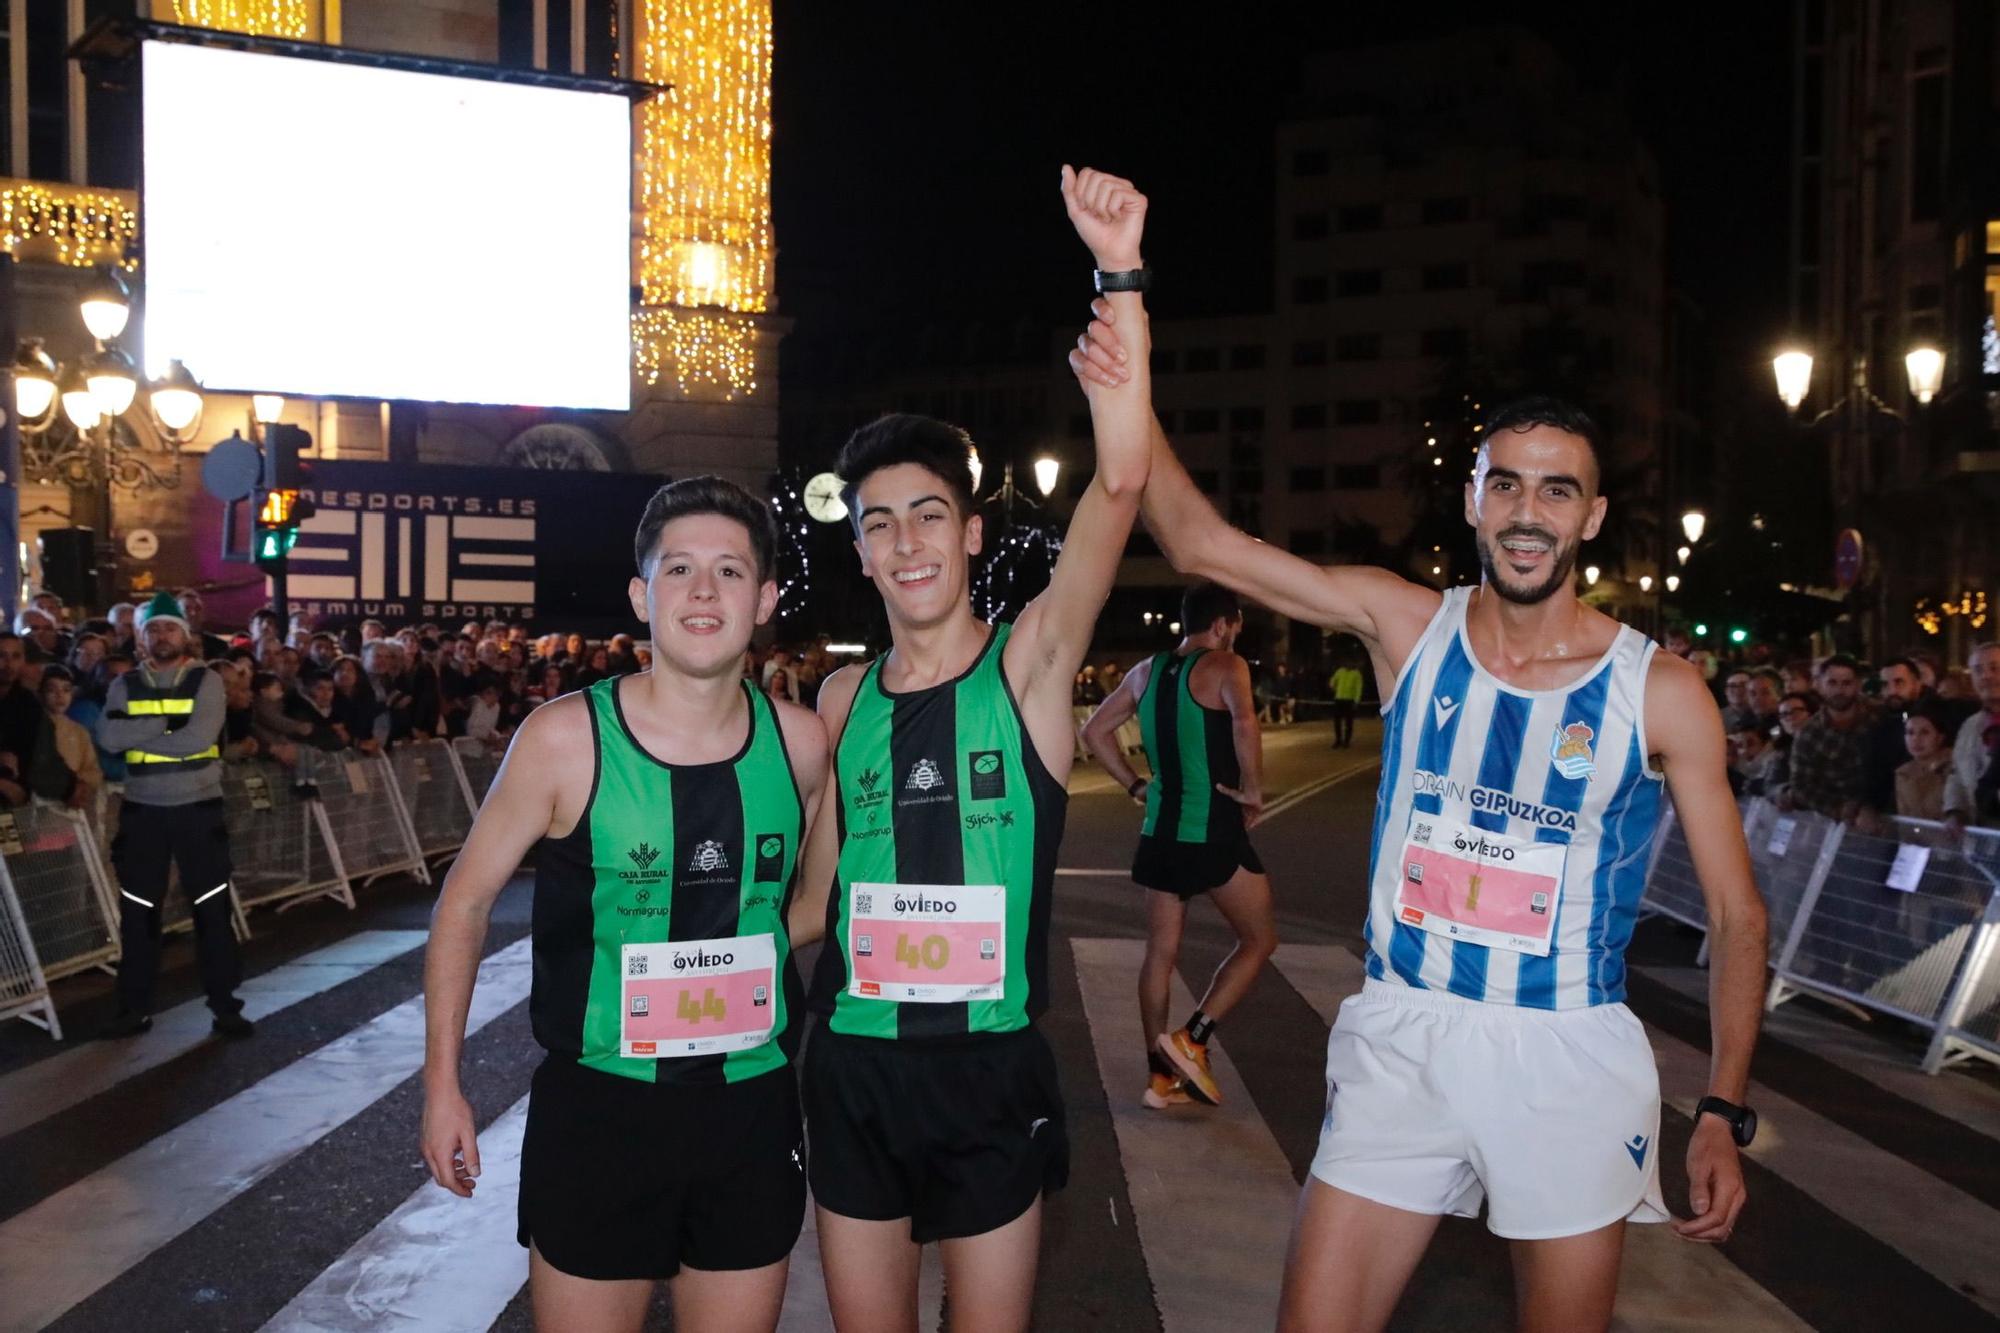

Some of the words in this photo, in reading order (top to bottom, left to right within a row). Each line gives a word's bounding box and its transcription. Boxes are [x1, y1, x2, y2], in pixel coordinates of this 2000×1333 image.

[1412, 772, 1465, 801] ORAIN
[1470, 788, 1577, 831] GIPUZKOA
[1454, 834, 1515, 861] OVIEDO
[640, 869, 669, 878] RURAL
[617, 904, 669, 918] Normagrup
[894, 891, 957, 913] OVIEDO
[673, 946, 734, 970] OVIEDO
[895, 933, 950, 970] 40
[676, 987, 727, 1025] 44
